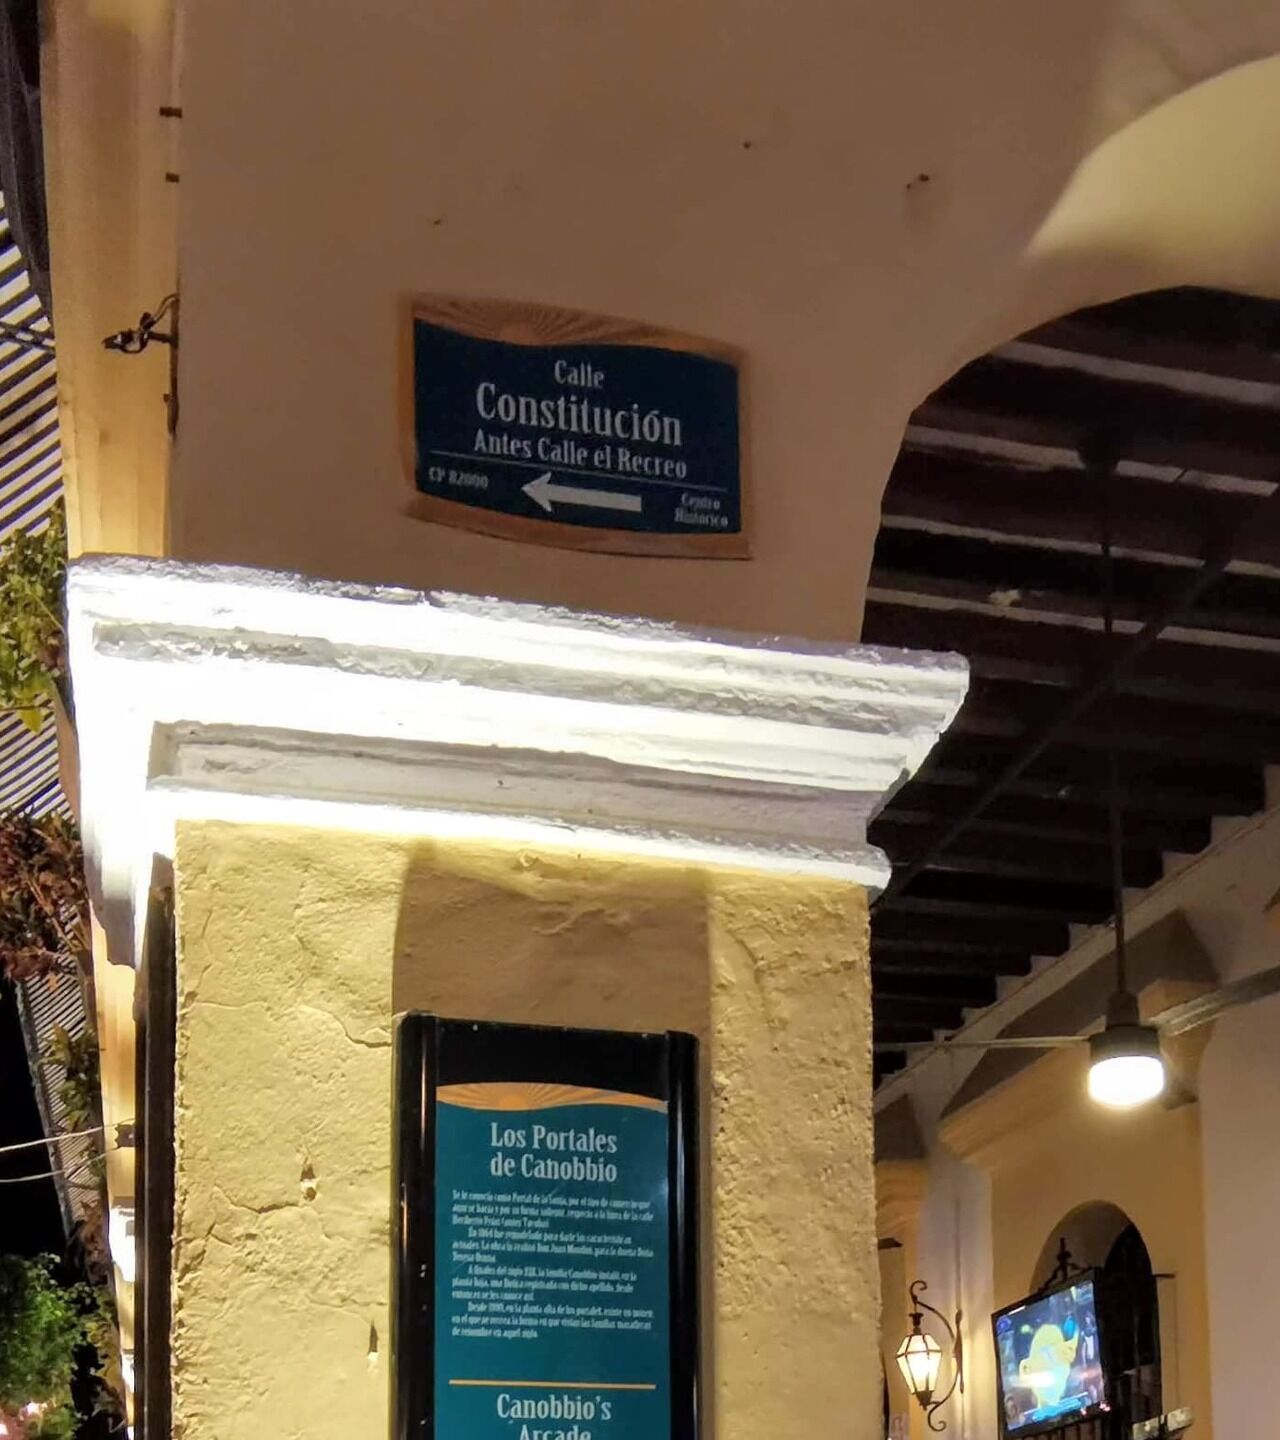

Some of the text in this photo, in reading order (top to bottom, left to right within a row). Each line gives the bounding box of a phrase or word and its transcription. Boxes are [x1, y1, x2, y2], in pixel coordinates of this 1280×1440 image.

[554, 360, 605, 389] Calle
[475, 382, 682, 447] Constitución
[473, 427, 687, 479] Antes Calle el Recreo
[490, 1121, 618, 1154] Los Portales
[489, 1151, 618, 1184] de Canobbio
[496, 1393, 613, 1422] Canobbio's
